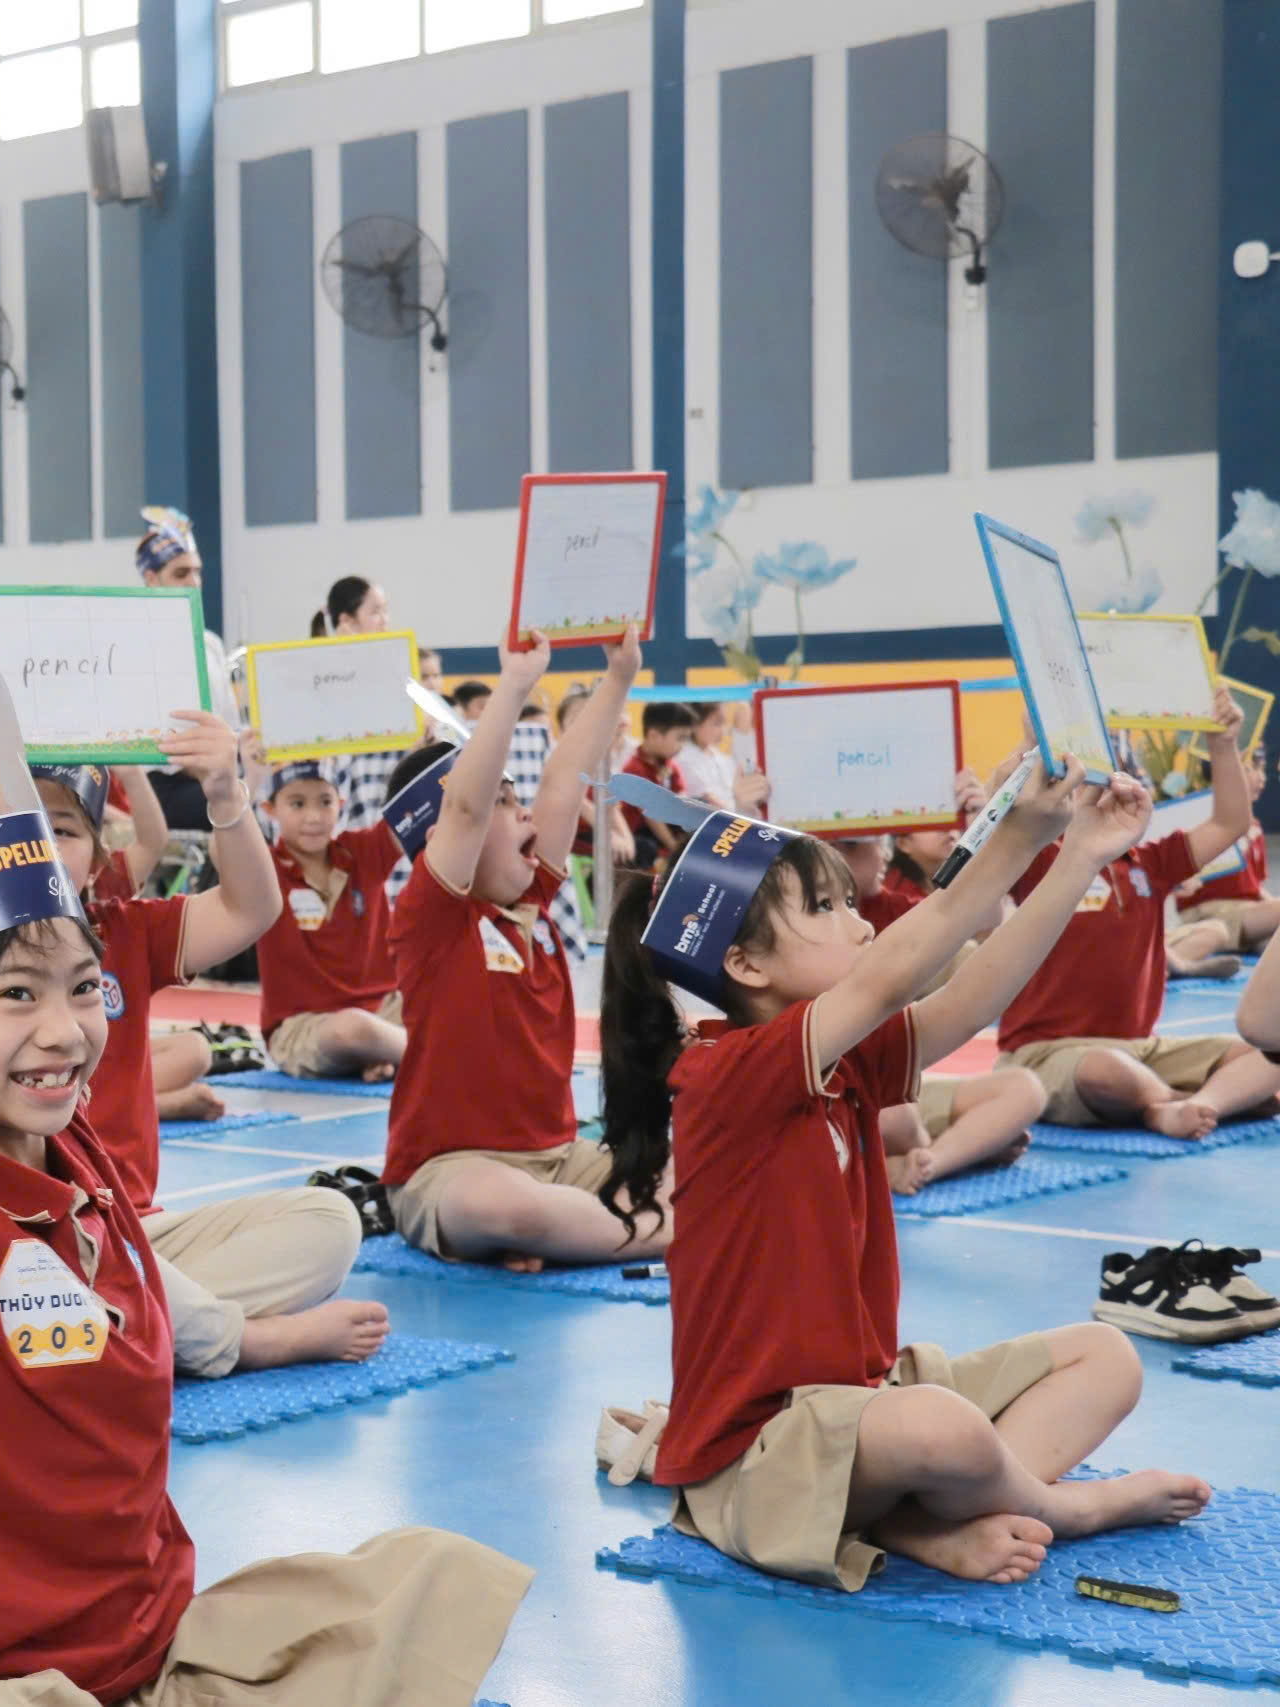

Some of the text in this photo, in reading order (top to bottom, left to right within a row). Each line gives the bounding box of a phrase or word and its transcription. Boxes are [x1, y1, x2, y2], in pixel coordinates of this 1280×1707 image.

[23, 642, 116, 689] pencil
[674, 921, 699, 953] bms
[698, 884, 717, 914] School
[18, 1323, 95, 1354] 205
